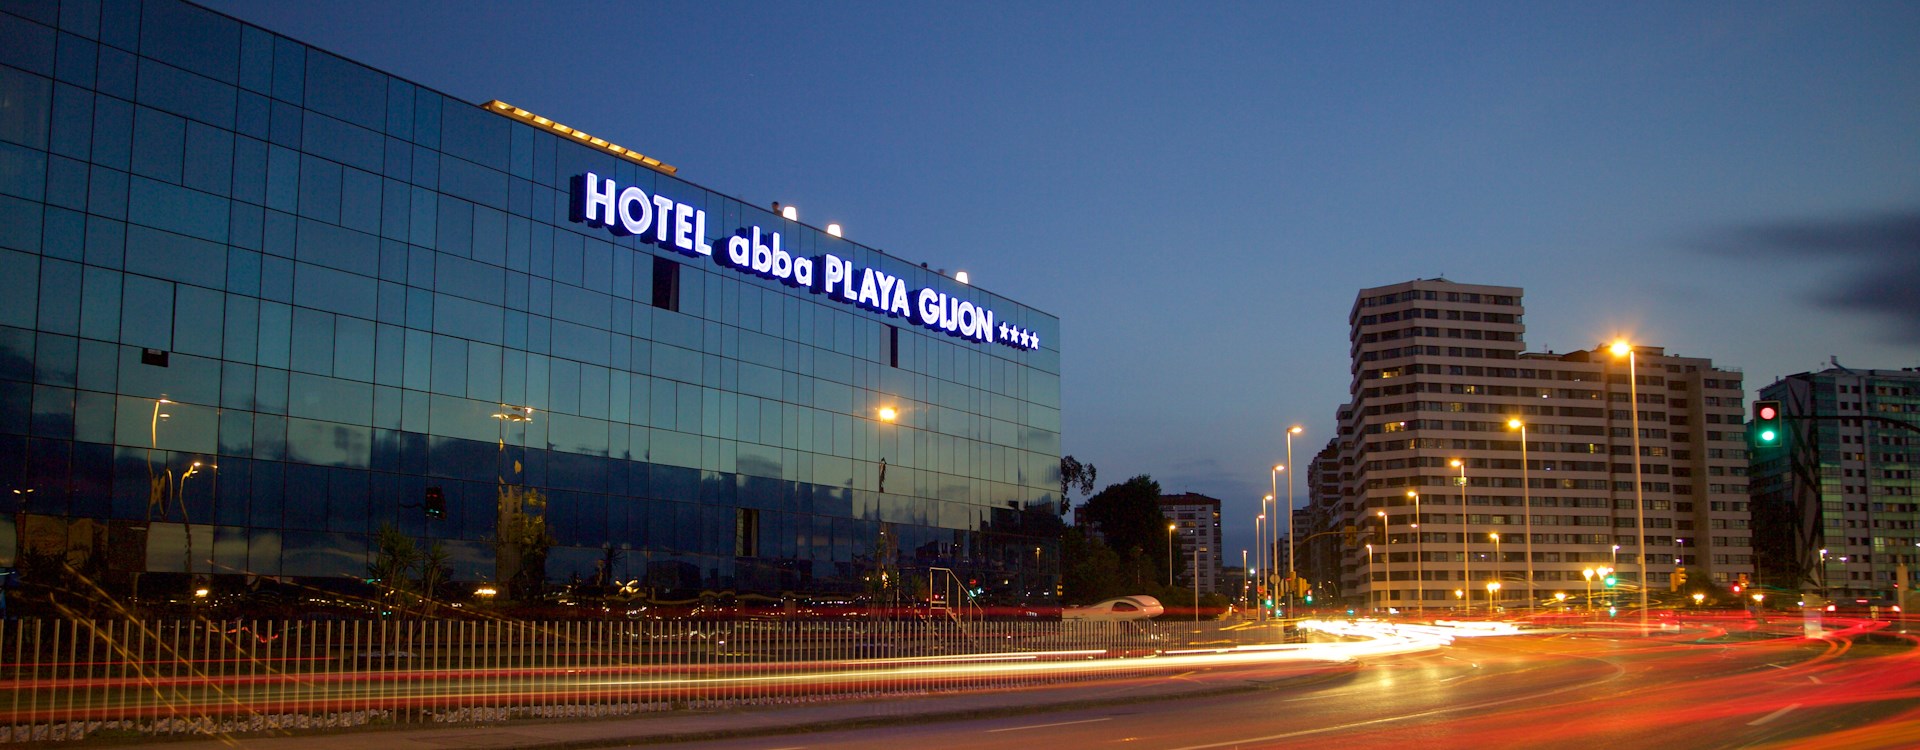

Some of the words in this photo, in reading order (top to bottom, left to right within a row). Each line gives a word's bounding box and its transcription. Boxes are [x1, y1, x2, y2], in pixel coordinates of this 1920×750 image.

[586, 172, 712, 255] HOTEL
[729, 226, 813, 287] abba
[826, 254, 911, 318] PLAYA
[919, 287, 994, 343] GIJON
